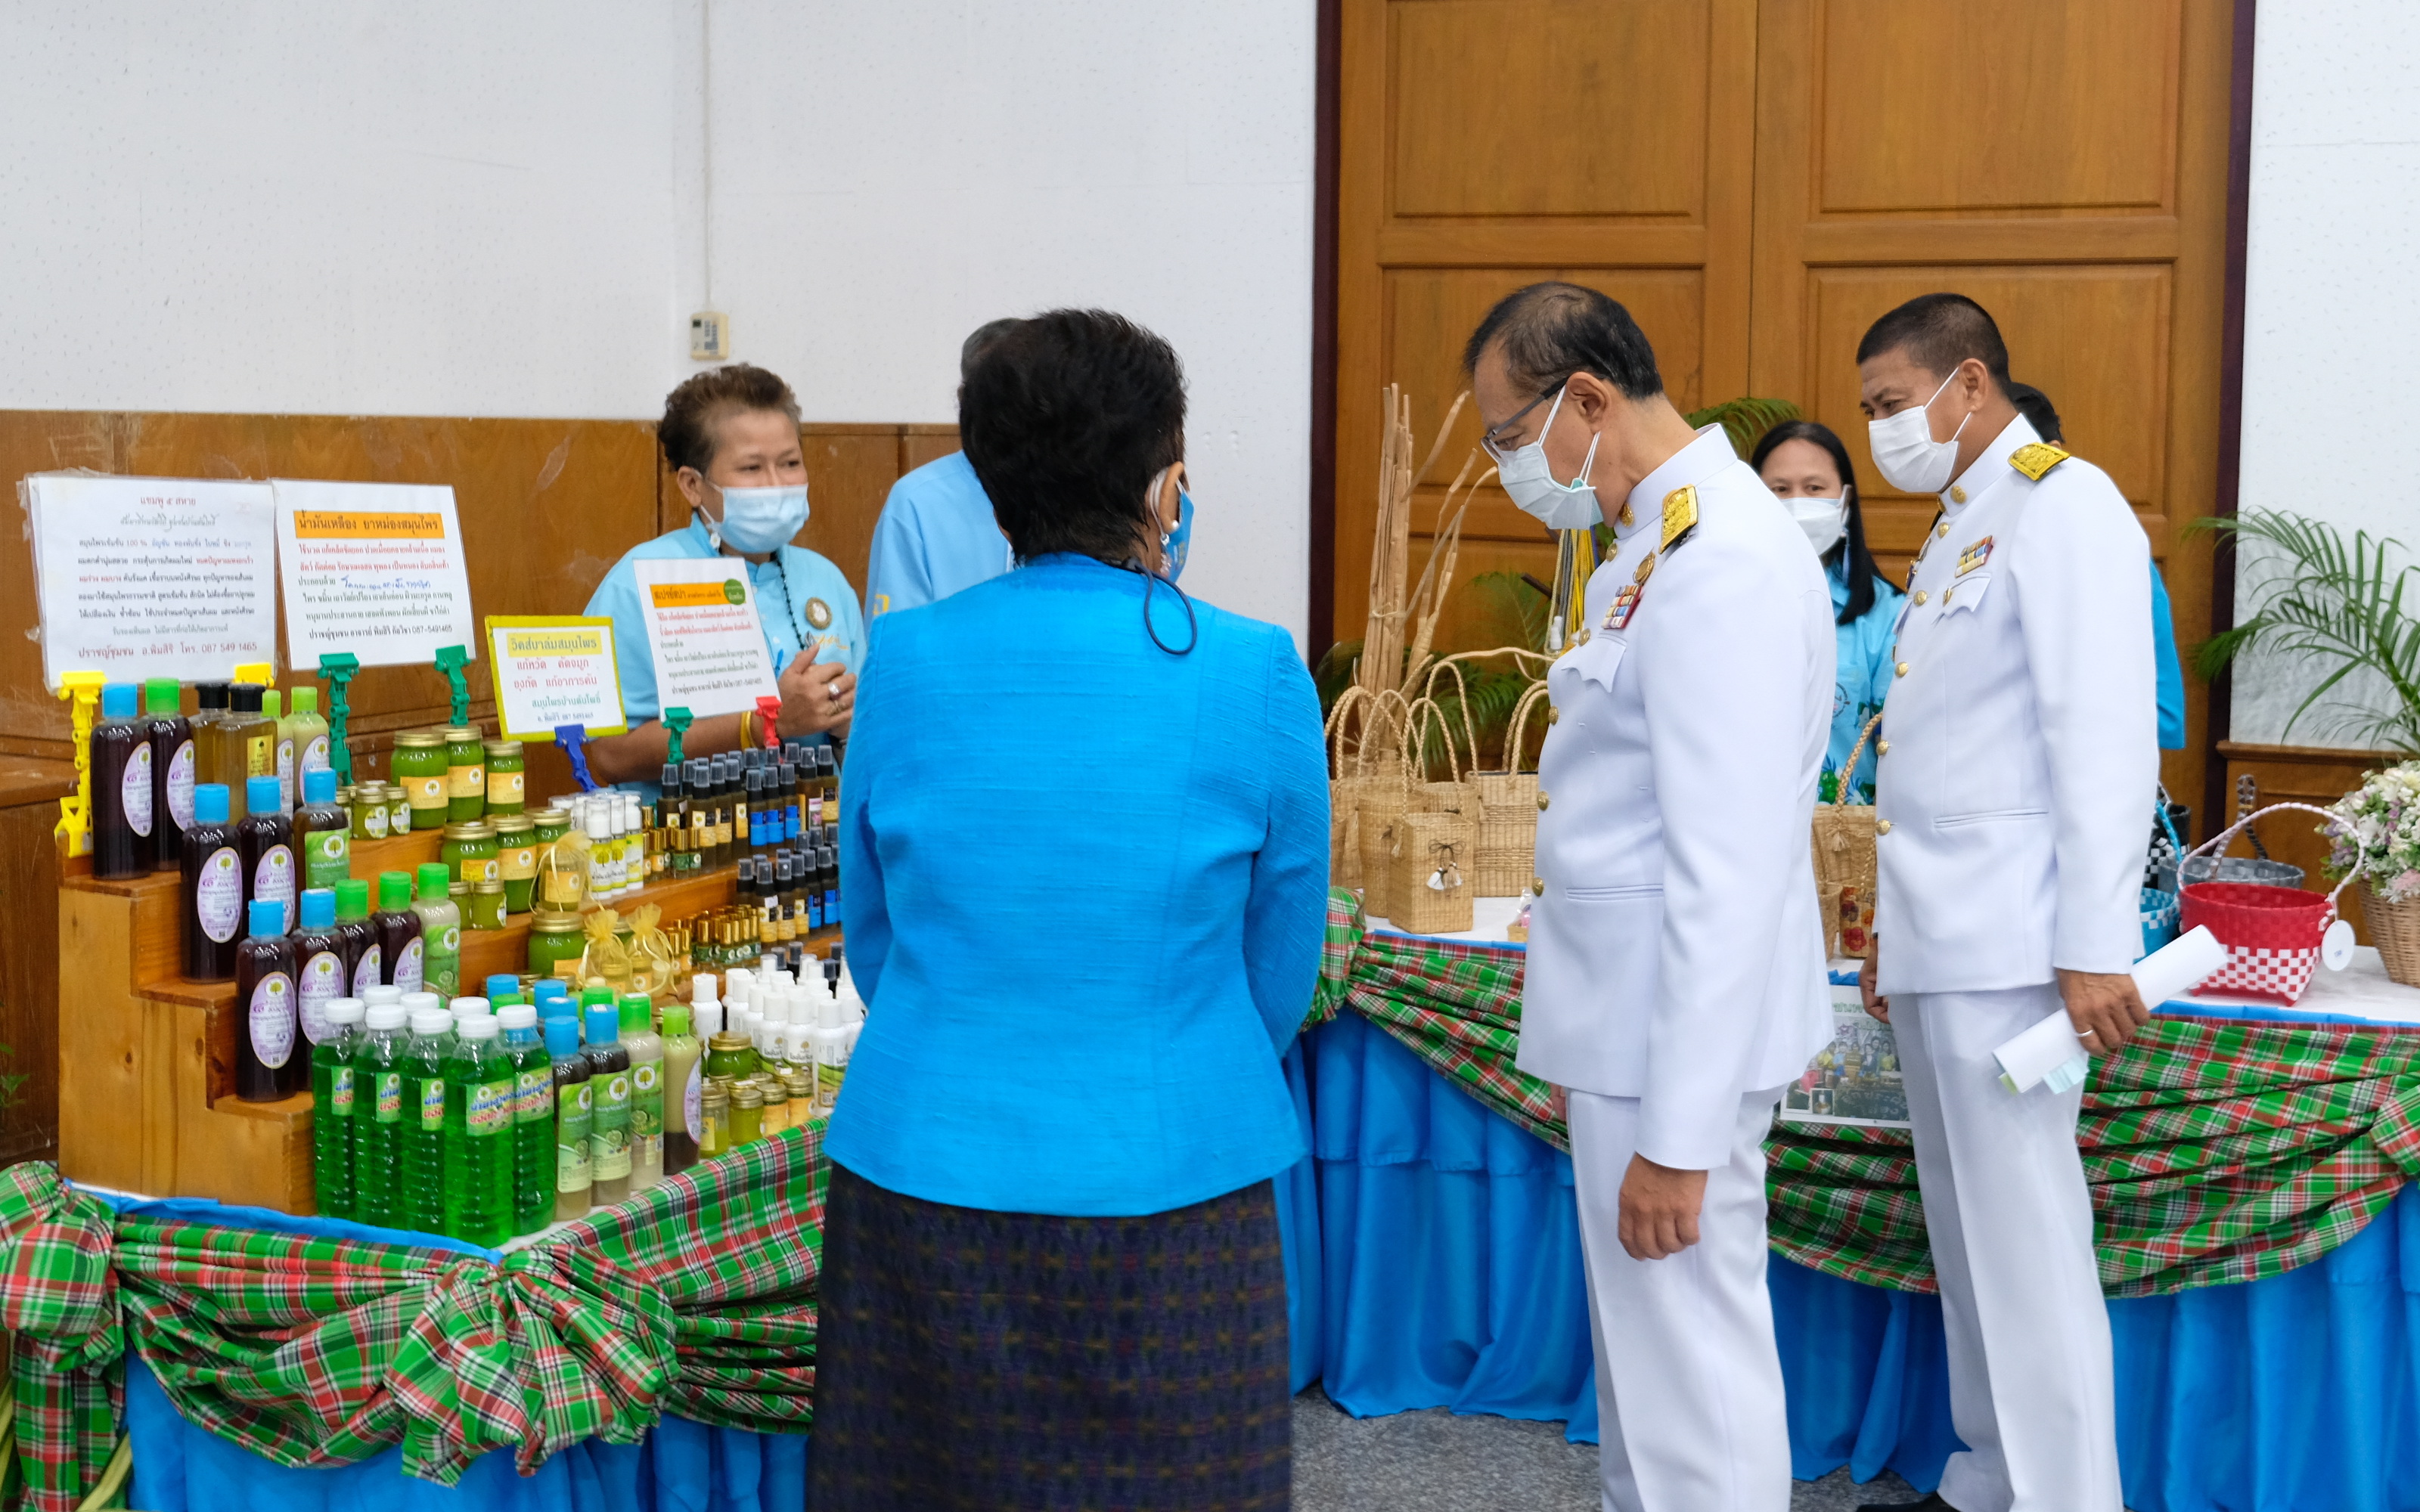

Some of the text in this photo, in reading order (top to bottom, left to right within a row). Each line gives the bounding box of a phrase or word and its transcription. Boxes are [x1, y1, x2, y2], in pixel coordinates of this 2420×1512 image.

[127, 539, 138, 547] 100
[201, 643, 217, 654] 087
[220, 643, 236, 653] 549
[238, 642, 257, 652] 1465
